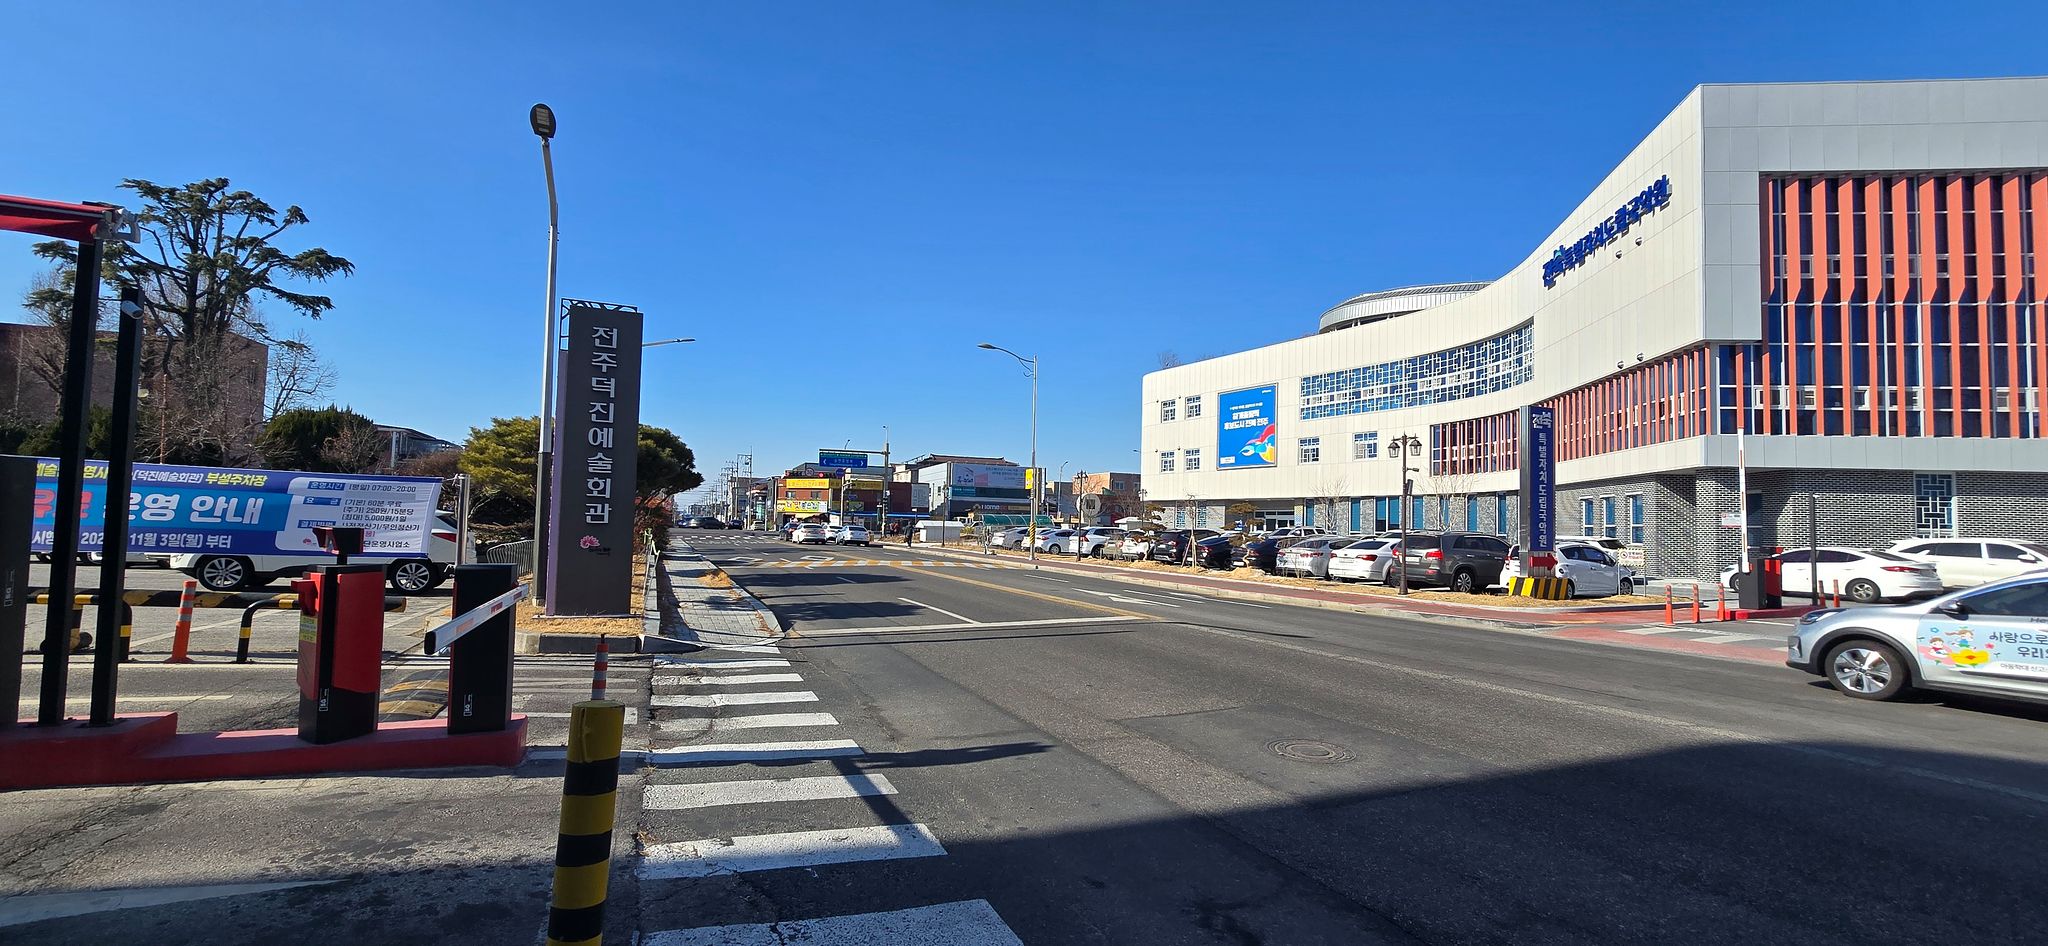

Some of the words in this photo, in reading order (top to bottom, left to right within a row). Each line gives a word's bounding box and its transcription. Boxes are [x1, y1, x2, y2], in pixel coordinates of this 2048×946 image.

[585, 325, 618, 525] 전주덕진예술회관
[205, 473, 268, 486] 부설주차장
[310, 481, 343, 490] 운영시간
[1538, 432, 1547, 548] 특별자치도립국악원
[190, 495, 265, 525] 안내
[160, 533, 203, 549] 3일(월)
[206, 534, 232, 549] 부터
[1989, 631, 2048, 646] 사랑으로
